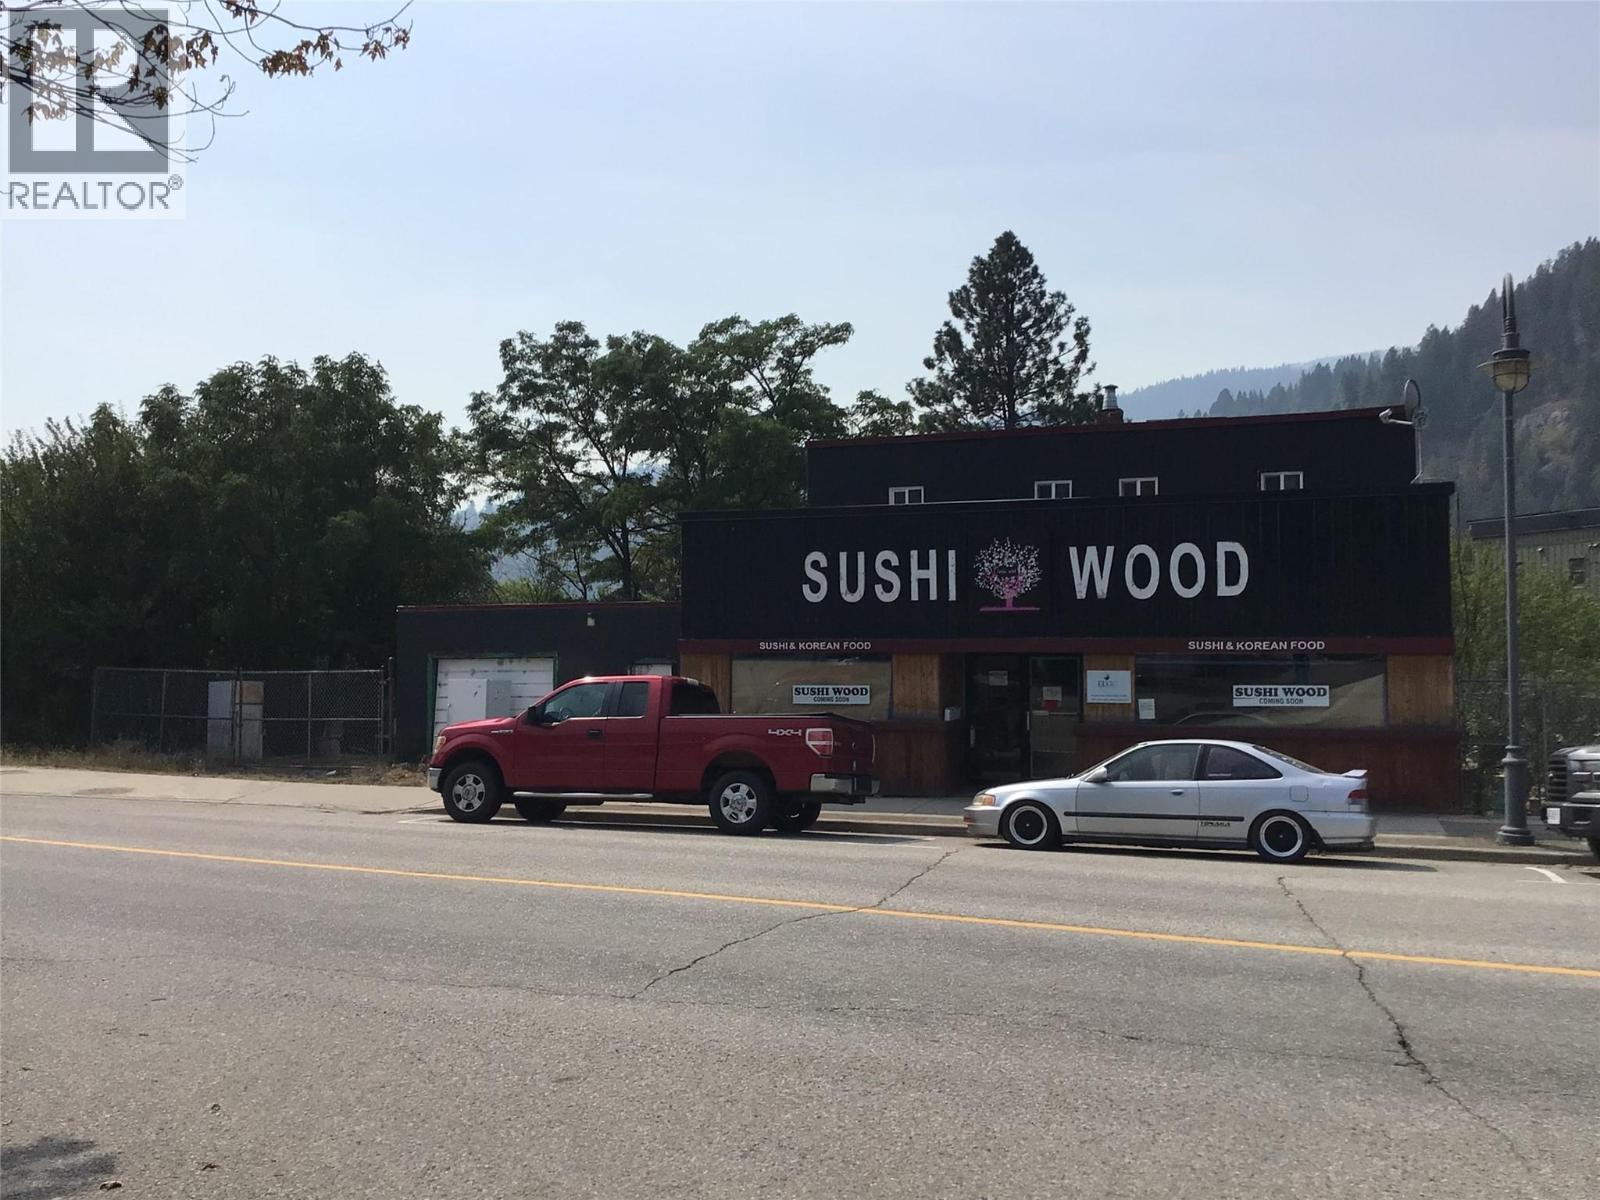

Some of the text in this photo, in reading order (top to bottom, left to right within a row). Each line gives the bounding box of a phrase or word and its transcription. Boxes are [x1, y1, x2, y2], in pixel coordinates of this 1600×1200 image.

[802, 541, 1249, 603] SUSHI WOOD
[759, 641, 788, 650] SUSHI
[799, 641, 840, 650] KOREAN
[843, 641, 872, 650] FOOD
[1188, 641, 1325, 651] SUSHI & KOREAN FOOD
[794, 687, 869, 696] SUSHI WOOD
[1235, 687, 1327, 697] SUSHI WOOD
